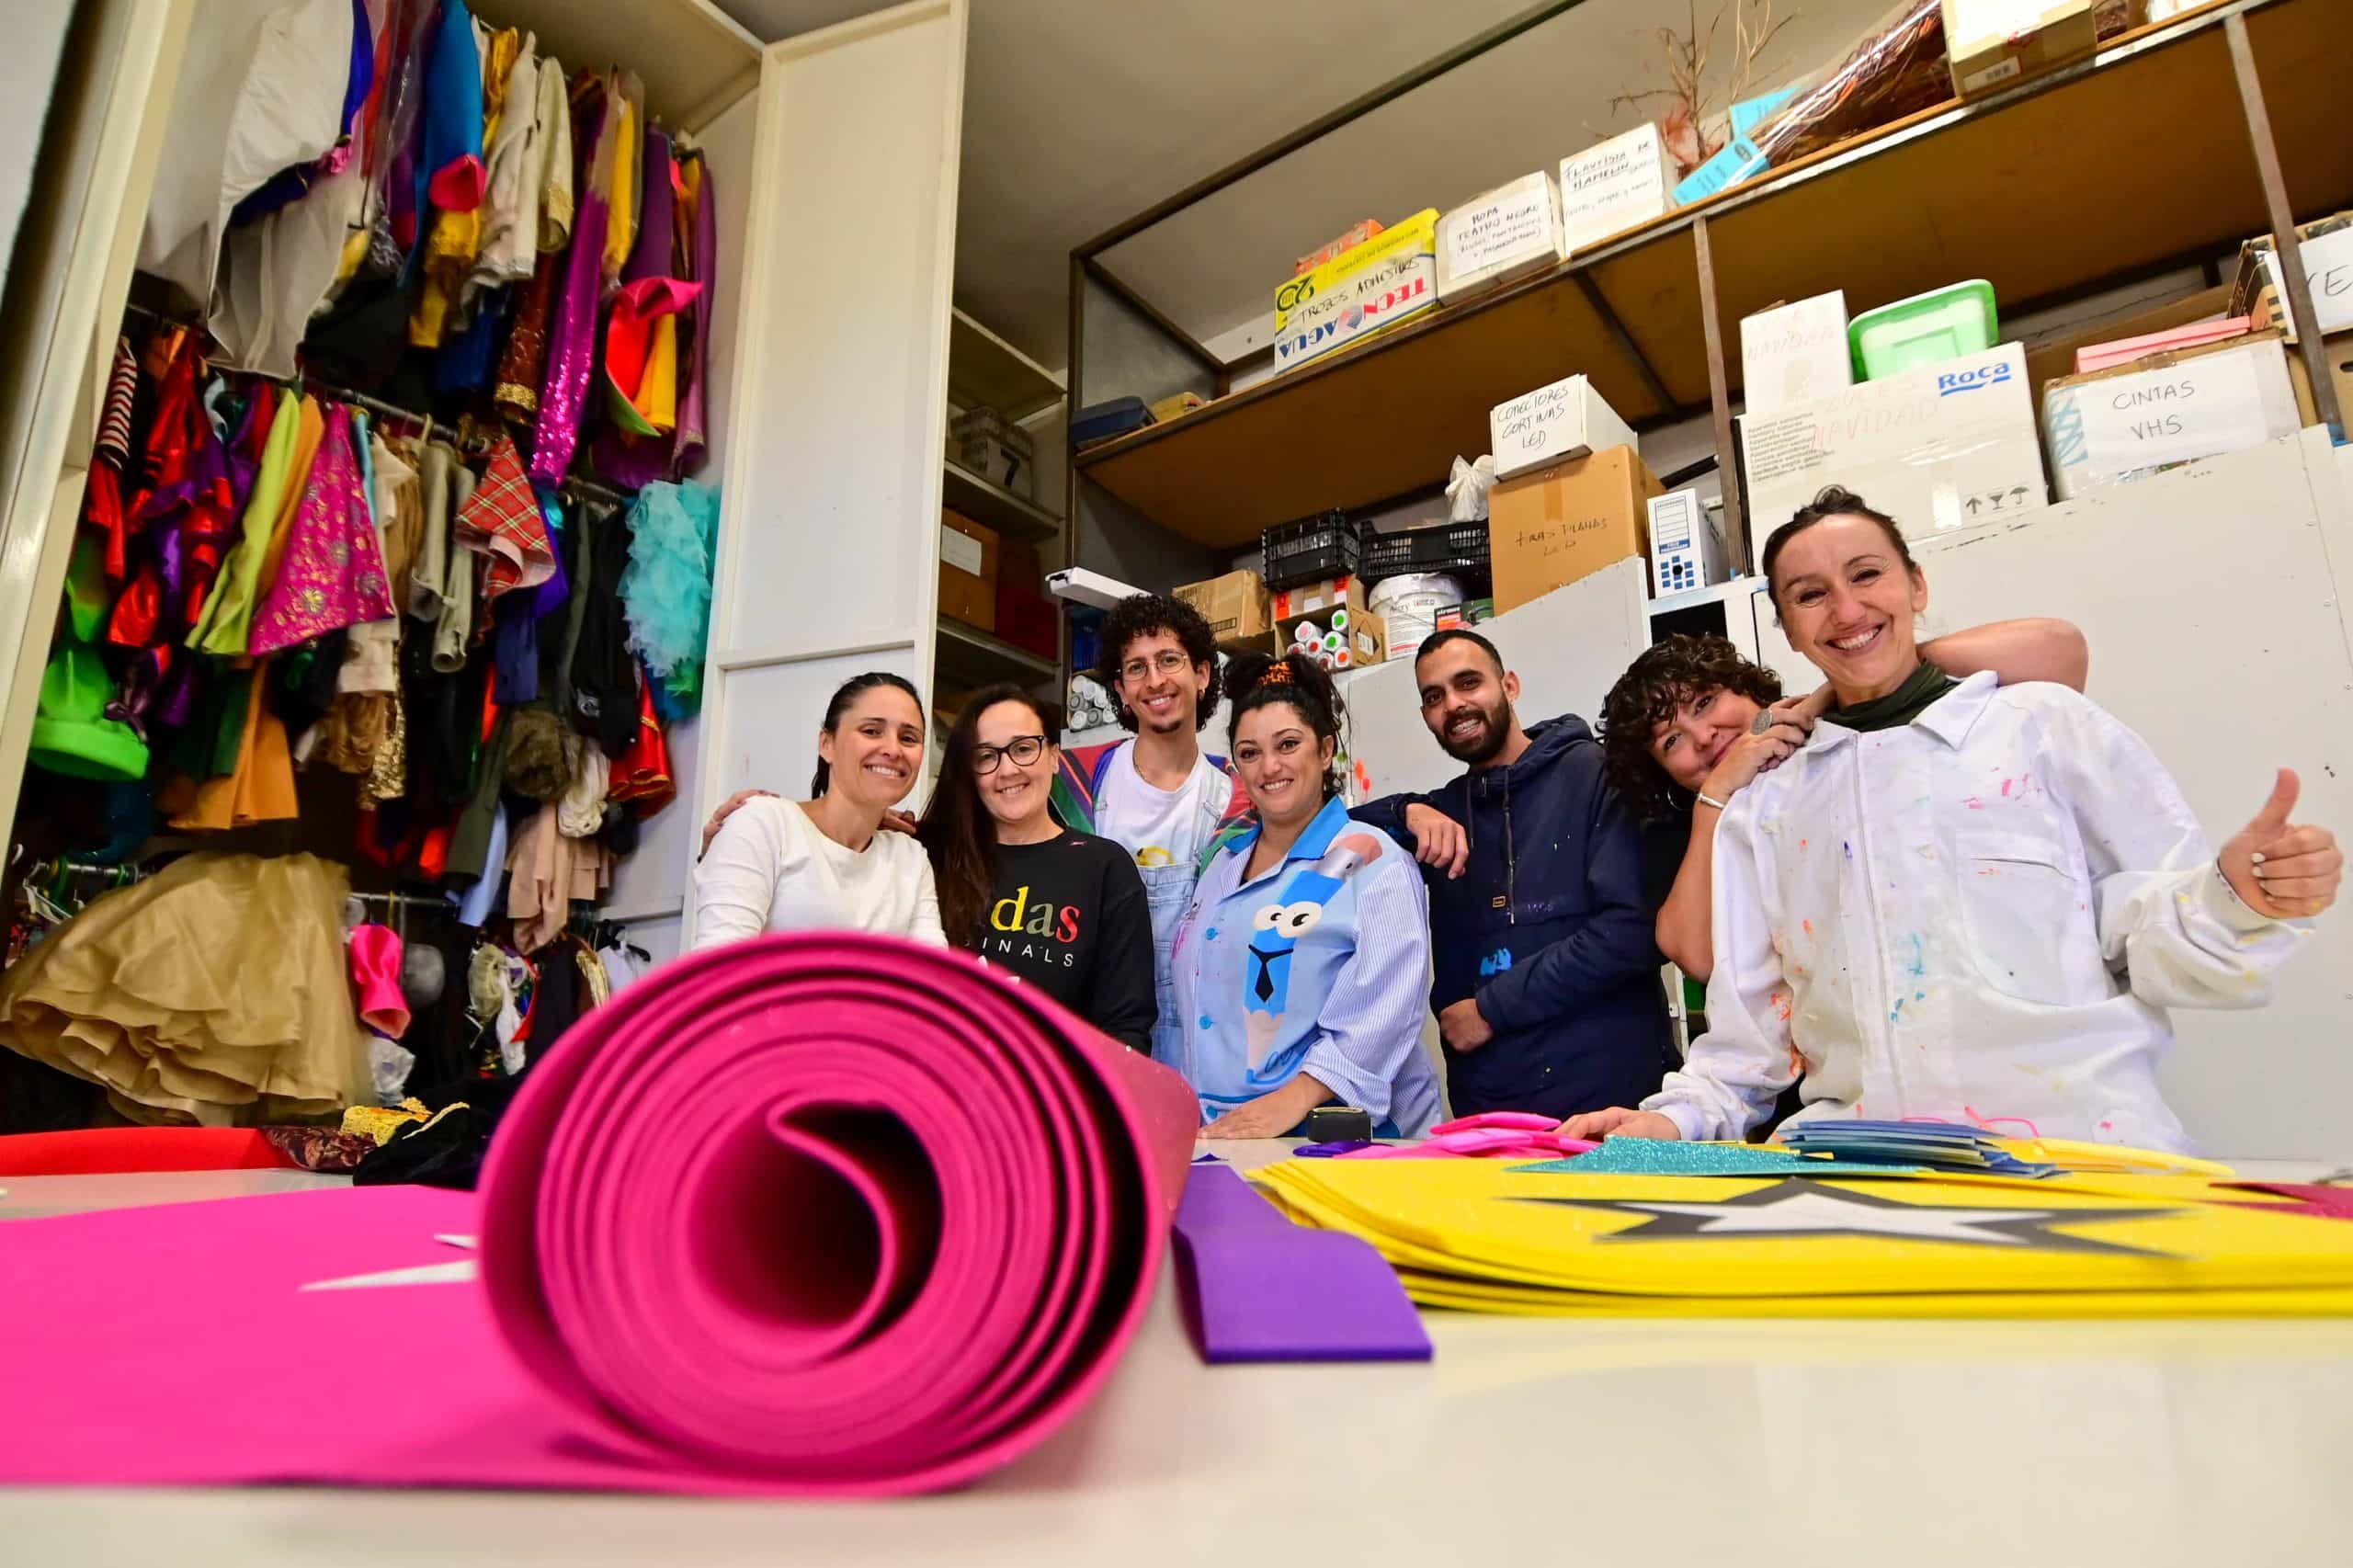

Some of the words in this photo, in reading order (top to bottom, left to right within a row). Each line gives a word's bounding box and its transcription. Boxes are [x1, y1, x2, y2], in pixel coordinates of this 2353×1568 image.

[1938, 361, 2010, 391] Roca
[1497, 385, 1568, 423] CONECTORES
[2112, 380, 2196, 410] CINTAS
[1502, 404, 1564, 438] CORTINAS
[2130, 414, 2184, 440] VHS
[1522, 429, 1546, 450] LED
[990, 884, 1081, 944] das
[965, 937, 1074, 968] INALS
